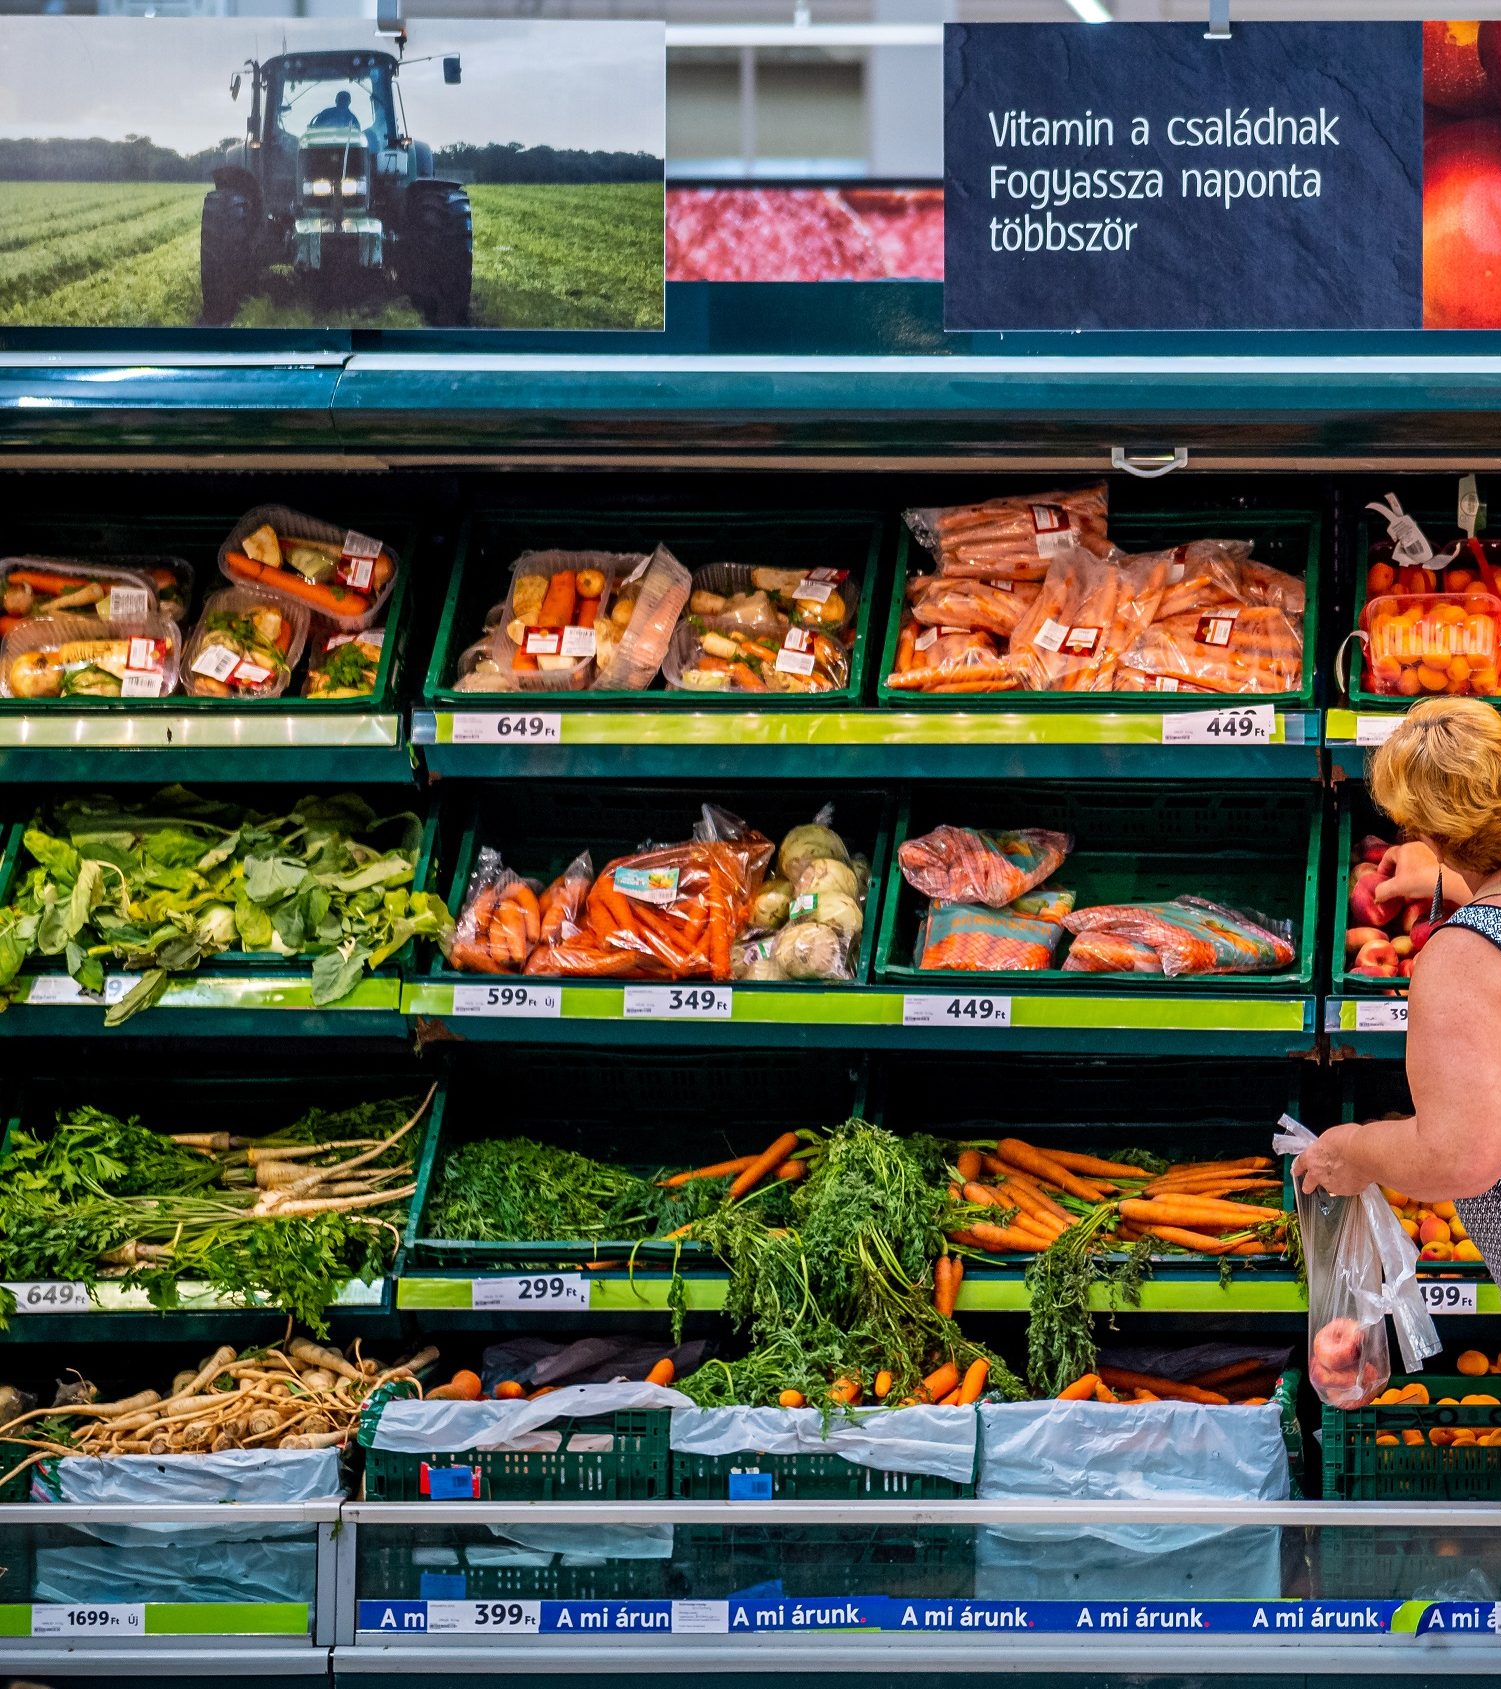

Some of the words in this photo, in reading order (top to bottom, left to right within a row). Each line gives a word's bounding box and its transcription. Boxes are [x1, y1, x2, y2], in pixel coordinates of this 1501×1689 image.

[988, 110, 1113, 148] Vitamin
[1130, 117, 1150, 147] a
[1167, 106, 1341, 149] családnak
[989, 164, 1164, 210] Fogyassza
[1182, 163, 1321, 210] naponta
[989, 212, 1138, 252] többször
[497, 717, 544, 736] 649
[545, 728, 555, 736] Ft
[1206, 717, 1253, 737] 449
[1254, 728, 1265, 737] Ft
[487, 988, 528, 1006] 599
[545, 998, 555, 1008] Új
[669, 990, 715, 1010] 349
[717, 1001, 727, 1010] Ft
[946, 999, 994, 1018] 449
[995, 1010, 1005, 1019] Ft
[27, 1285, 74, 1305] 649
[75, 1296, 85, 1304] Ft
[518, 1277, 564, 1299] 299
[567, 1287, 576, 1297] Ft
[1462, 1297, 1472, 1306] Ft
[67, 1611, 109, 1626] 1699
[111, 1617, 120, 1625] Ft
[128, 1613, 138, 1626] Új
[380, 1608, 397, 1627] A
[474, 1604, 523, 1625] 399
[525, 1615, 536, 1625] Ft
[557, 1608, 573, 1628] A
[580, 1607, 609, 1627] mi
[732, 1606, 749, 1626] A
[756, 1605, 784, 1626] mi
[791, 1603, 867, 1625] árunk.
[901, 1606, 918, 1626] A
[925, 1605, 953, 1626] mi
[959, 1606, 1035, 1627] árunk.
[1077, 1607, 1093, 1627] A
[1100, 1607, 1128, 1627] mi
[1135, 1607, 1210, 1628] árunk.
[1252, 1607, 1269, 1627] A
[1275, 1607, 1303, 1627] mi
[1311, 1607, 1385, 1628] árunk.
[1428, 1609, 1445, 1628] A
[1452, 1608, 1479, 1628] mi
